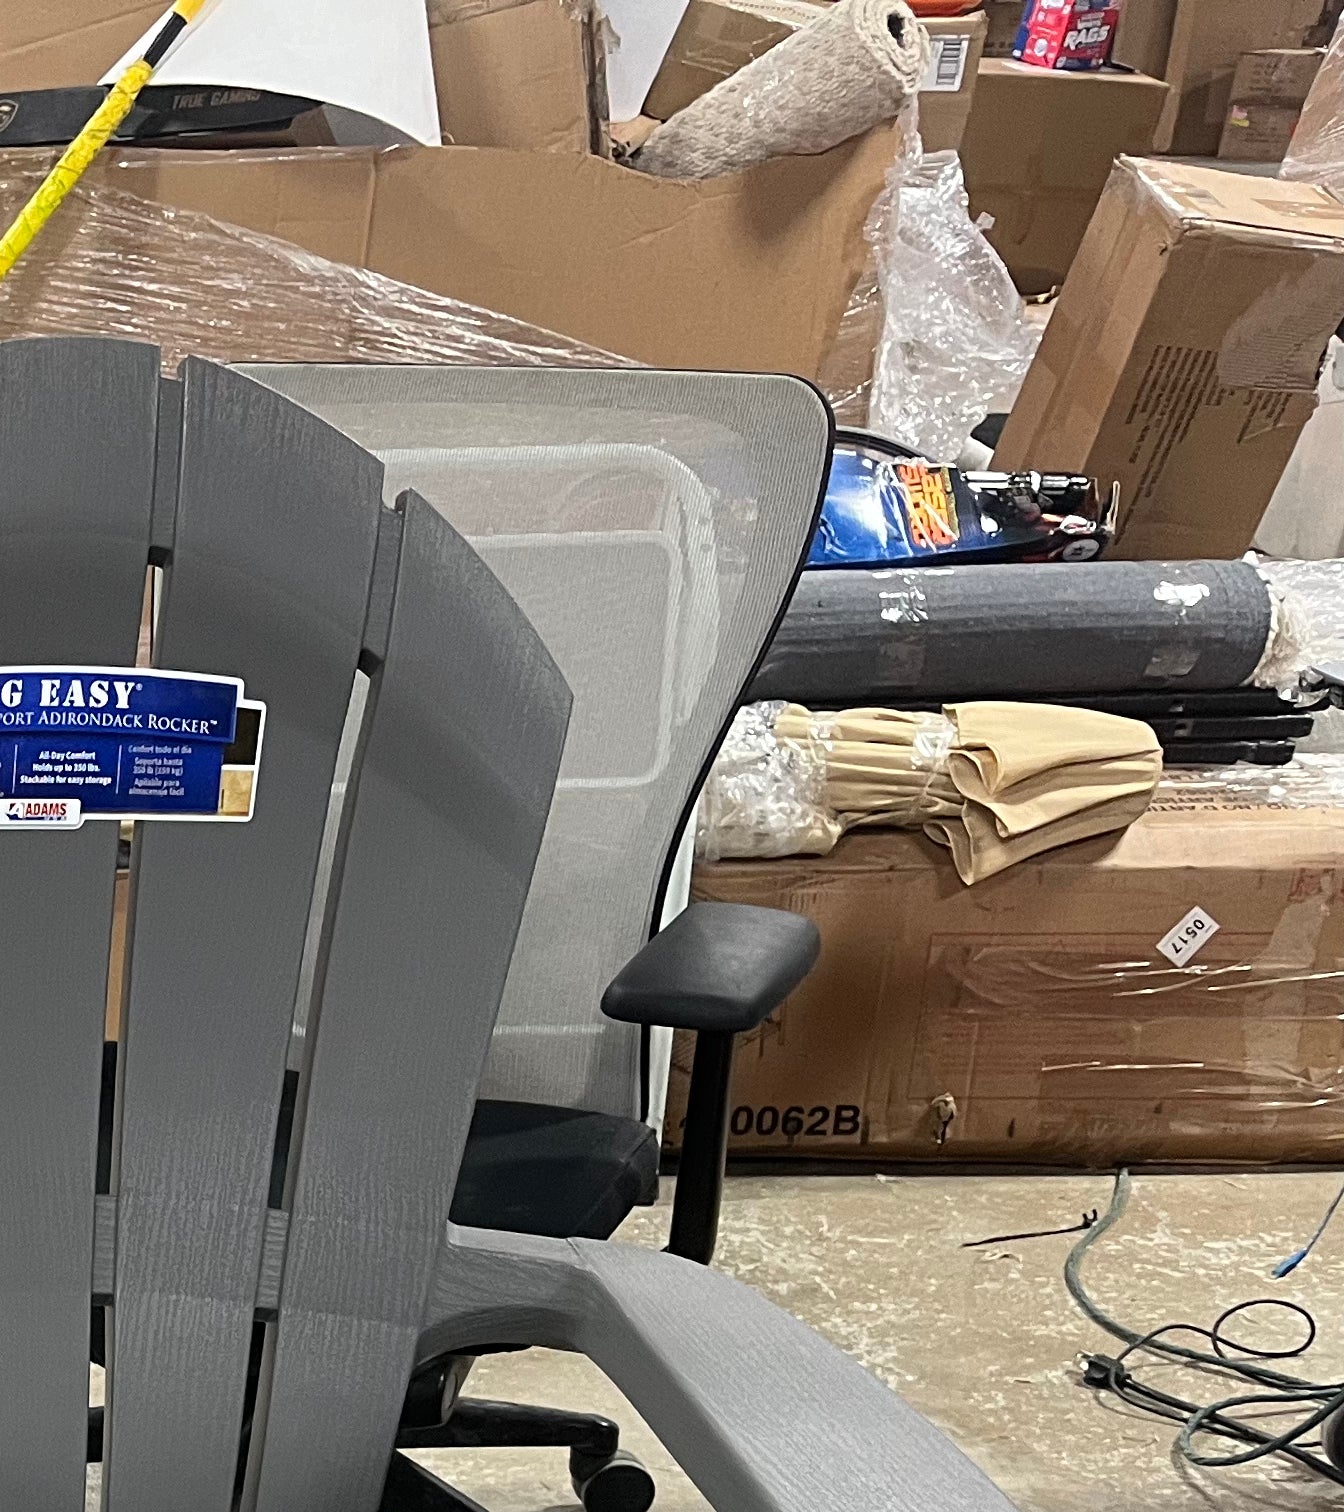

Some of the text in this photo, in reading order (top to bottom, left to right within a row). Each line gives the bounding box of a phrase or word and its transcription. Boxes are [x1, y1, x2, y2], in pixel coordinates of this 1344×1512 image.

[1063, 25, 1110, 51] RAGS
[38, 711, 143, 728] ADIRONDACK
[66, 751, 96, 760] Comfort
[33, 763, 53, 771] Holds
[54, 764, 63, 773] up
[65, 763, 72, 771] to
[20, 775, 112, 786] Stackable for easy storage
[26, 802, 67, 816] ADAMS
[1172, 918, 1206, 954] 0517
[726, 1104, 860, 1136] 0062B
